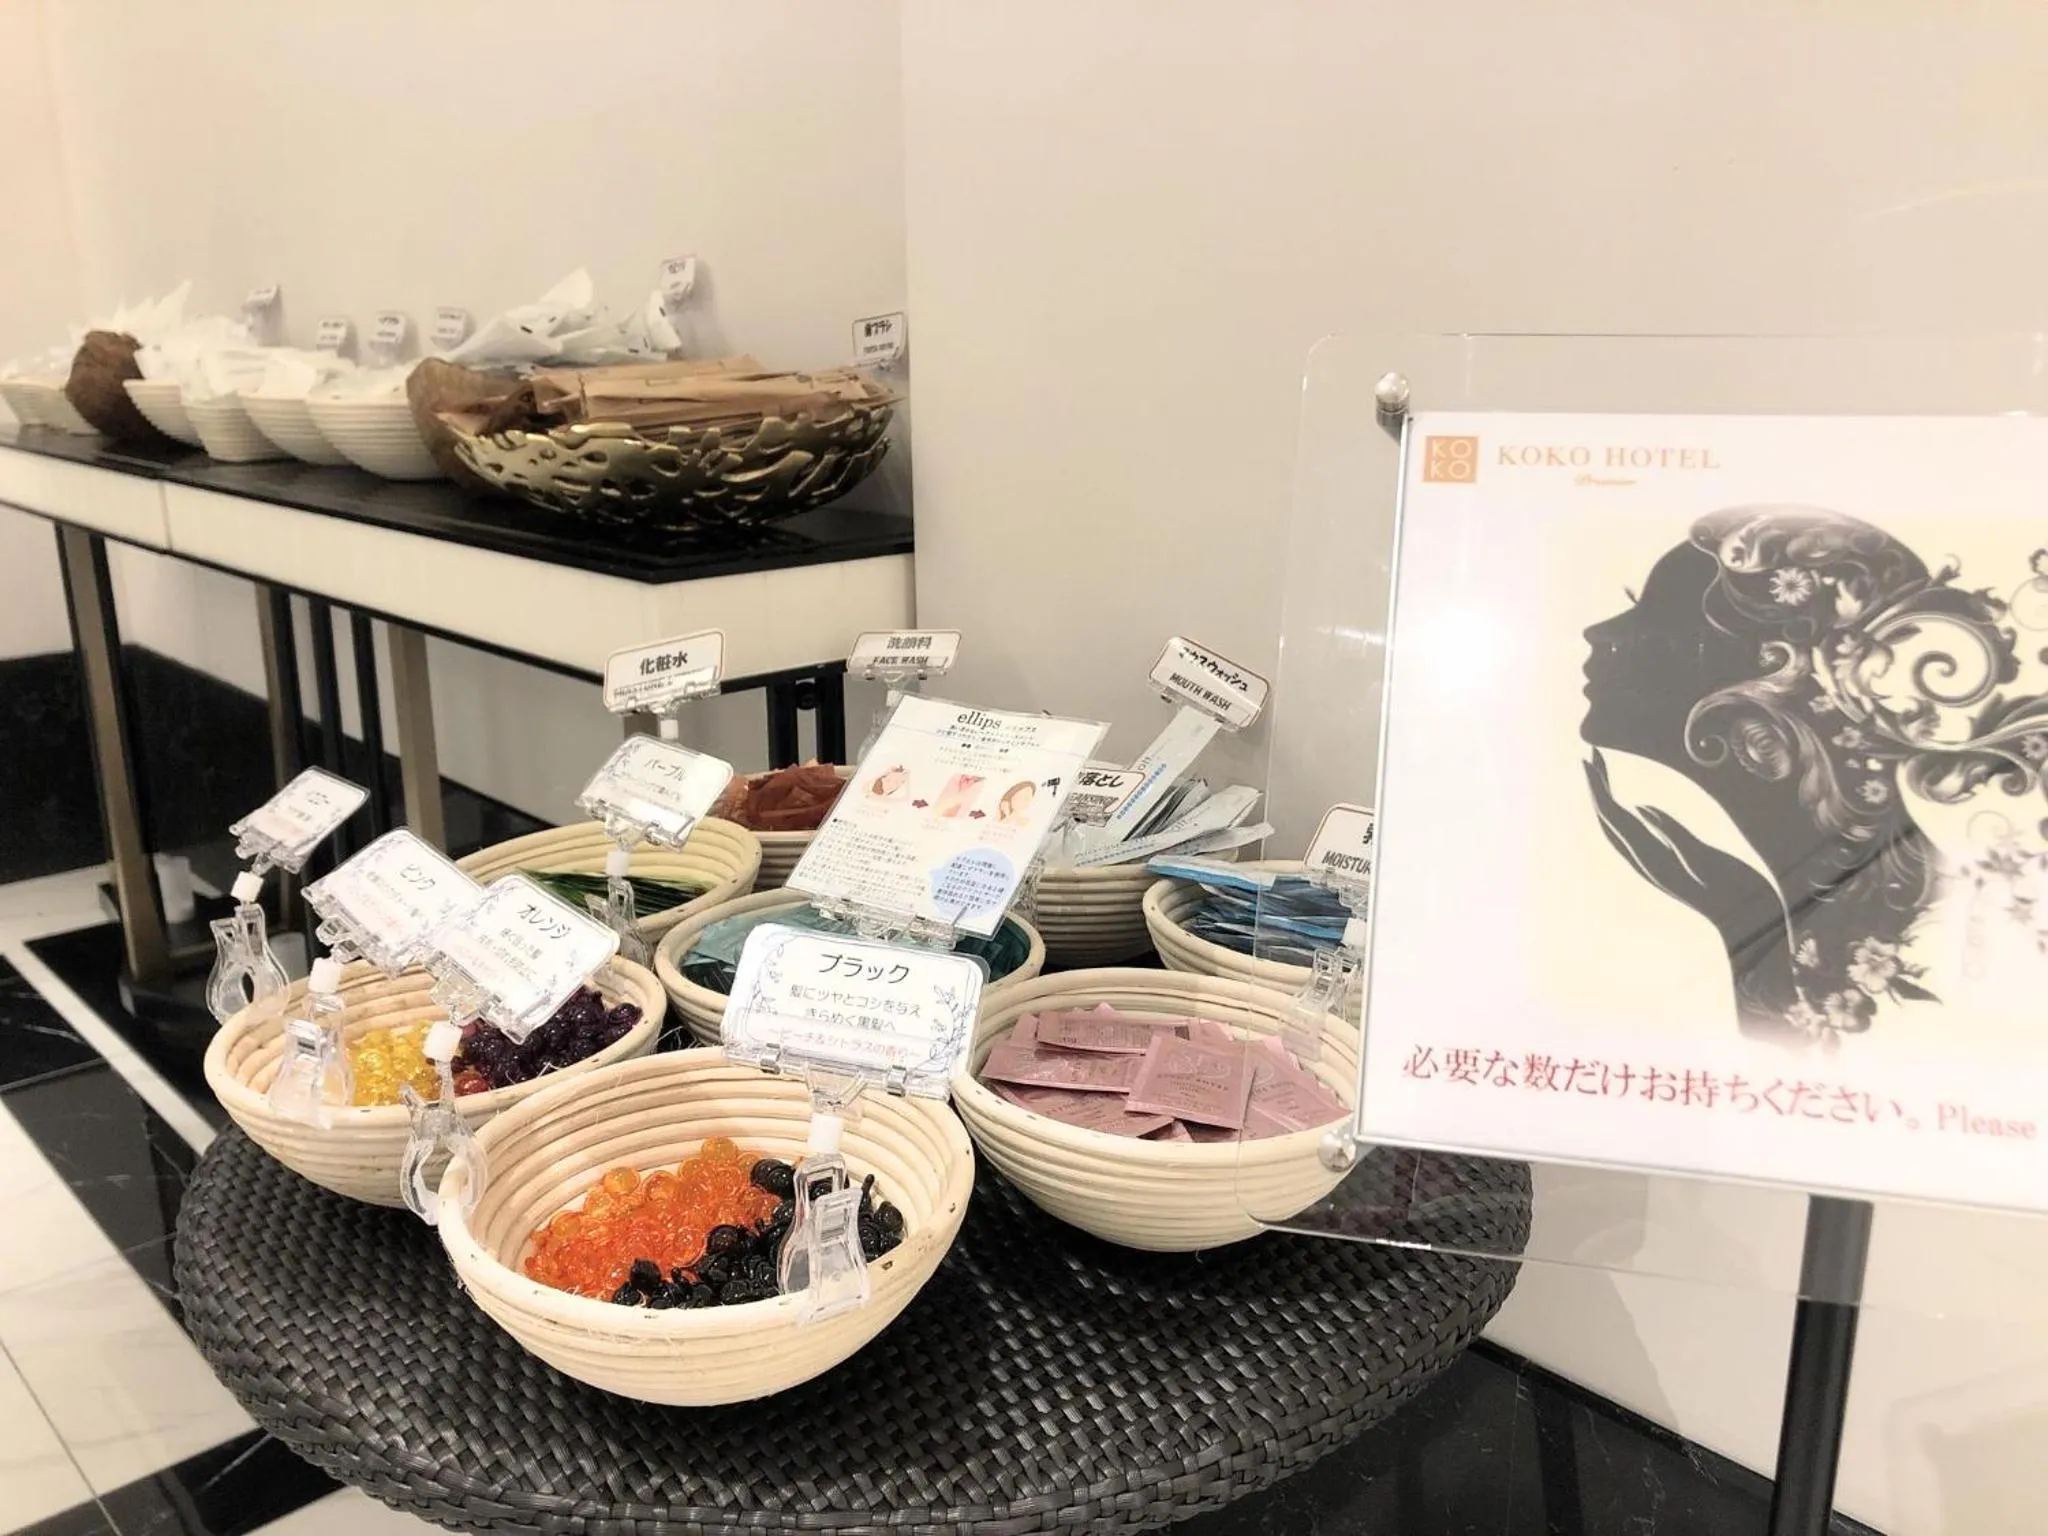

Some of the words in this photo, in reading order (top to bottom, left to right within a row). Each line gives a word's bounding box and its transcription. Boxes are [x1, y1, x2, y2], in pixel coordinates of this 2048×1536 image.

[1431, 439, 1473, 459] KO
[1497, 445, 1592, 466] KOKO
[1604, 447, 1721, 469] HOTEL
[1429, 459, 1471, 480] KO
[640, 651, 688, 675] 化粧水
[873, 656, 897, 665] FACE
[901, 656, 929, 665] WASH
[1169, 672, 1202, 697] MOUTH
[1203, 690, 1232, 711] WASH
[957, 711, 1002, 730] ellips
[517, 904, 572, 939] オレンジ
[818, 953, 910, 984] ブラック
[1402, 1043, 1922, 1131] 必要な数だけお持ちください。
[1937, 1102, 2037, 1141] Please
